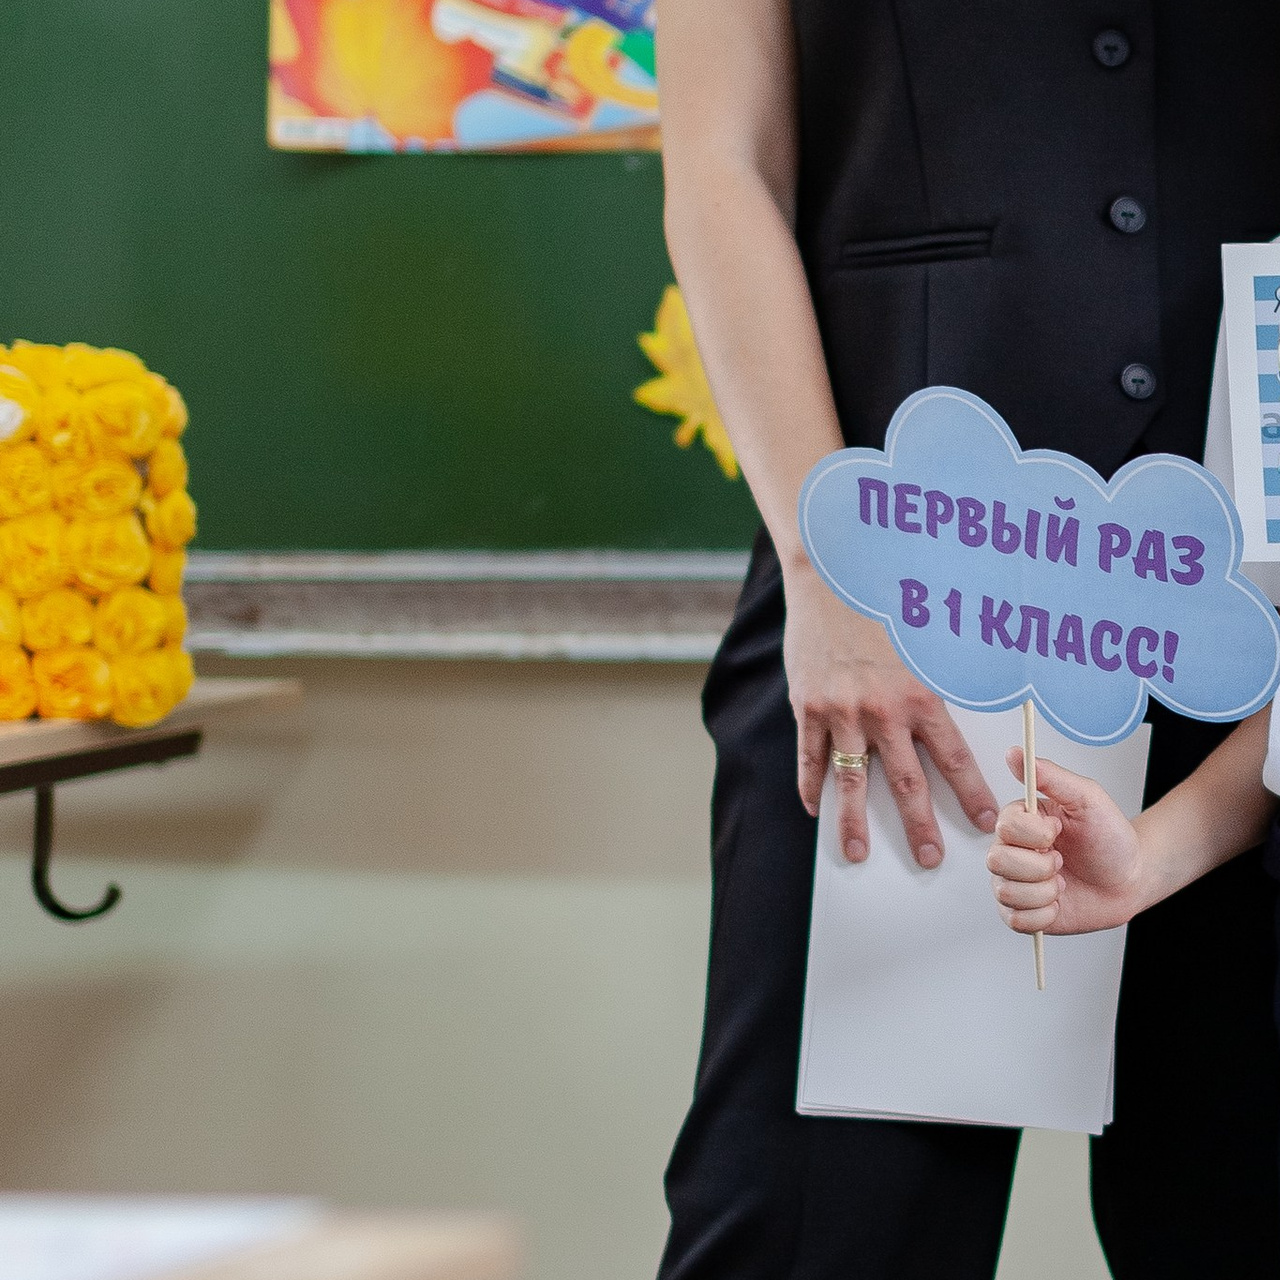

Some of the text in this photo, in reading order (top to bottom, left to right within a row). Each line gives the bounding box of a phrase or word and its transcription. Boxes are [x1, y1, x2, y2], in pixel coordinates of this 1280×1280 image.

[857, 476, 1206, 586] ПЕРВЫЙ РАЗ
[899, 577, 1181, 685] В 1 КЛАСС!
